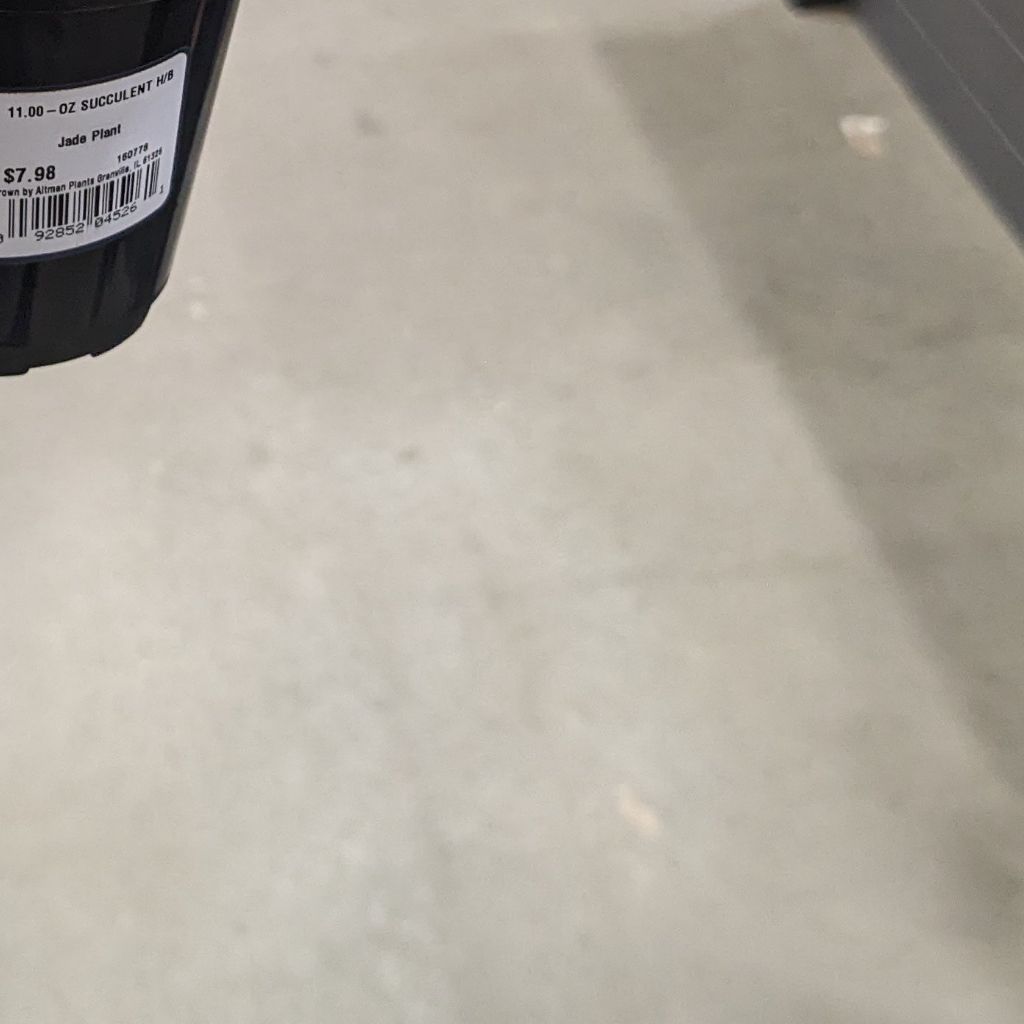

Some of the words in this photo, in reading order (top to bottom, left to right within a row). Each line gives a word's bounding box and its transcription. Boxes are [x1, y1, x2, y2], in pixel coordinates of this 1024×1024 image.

[81, 80, 153, 111] SUCCULENT
[156, 69, 174, 87] H/B
[57, 134, 87, 148] Jade
[91, 124, 122, 142] Plant
[3, 165, 56, 184] $7.98
[22, 187, 33, 198] by
[35, 183, 66, 195] Altman
[68, 177, 95, 190] Plants
[133, 160, 141, 169] IL
[34, 222, 85, 241] 92852
[95, 202, 138, 228] 04526
[159, 184, 164, 194] 1
